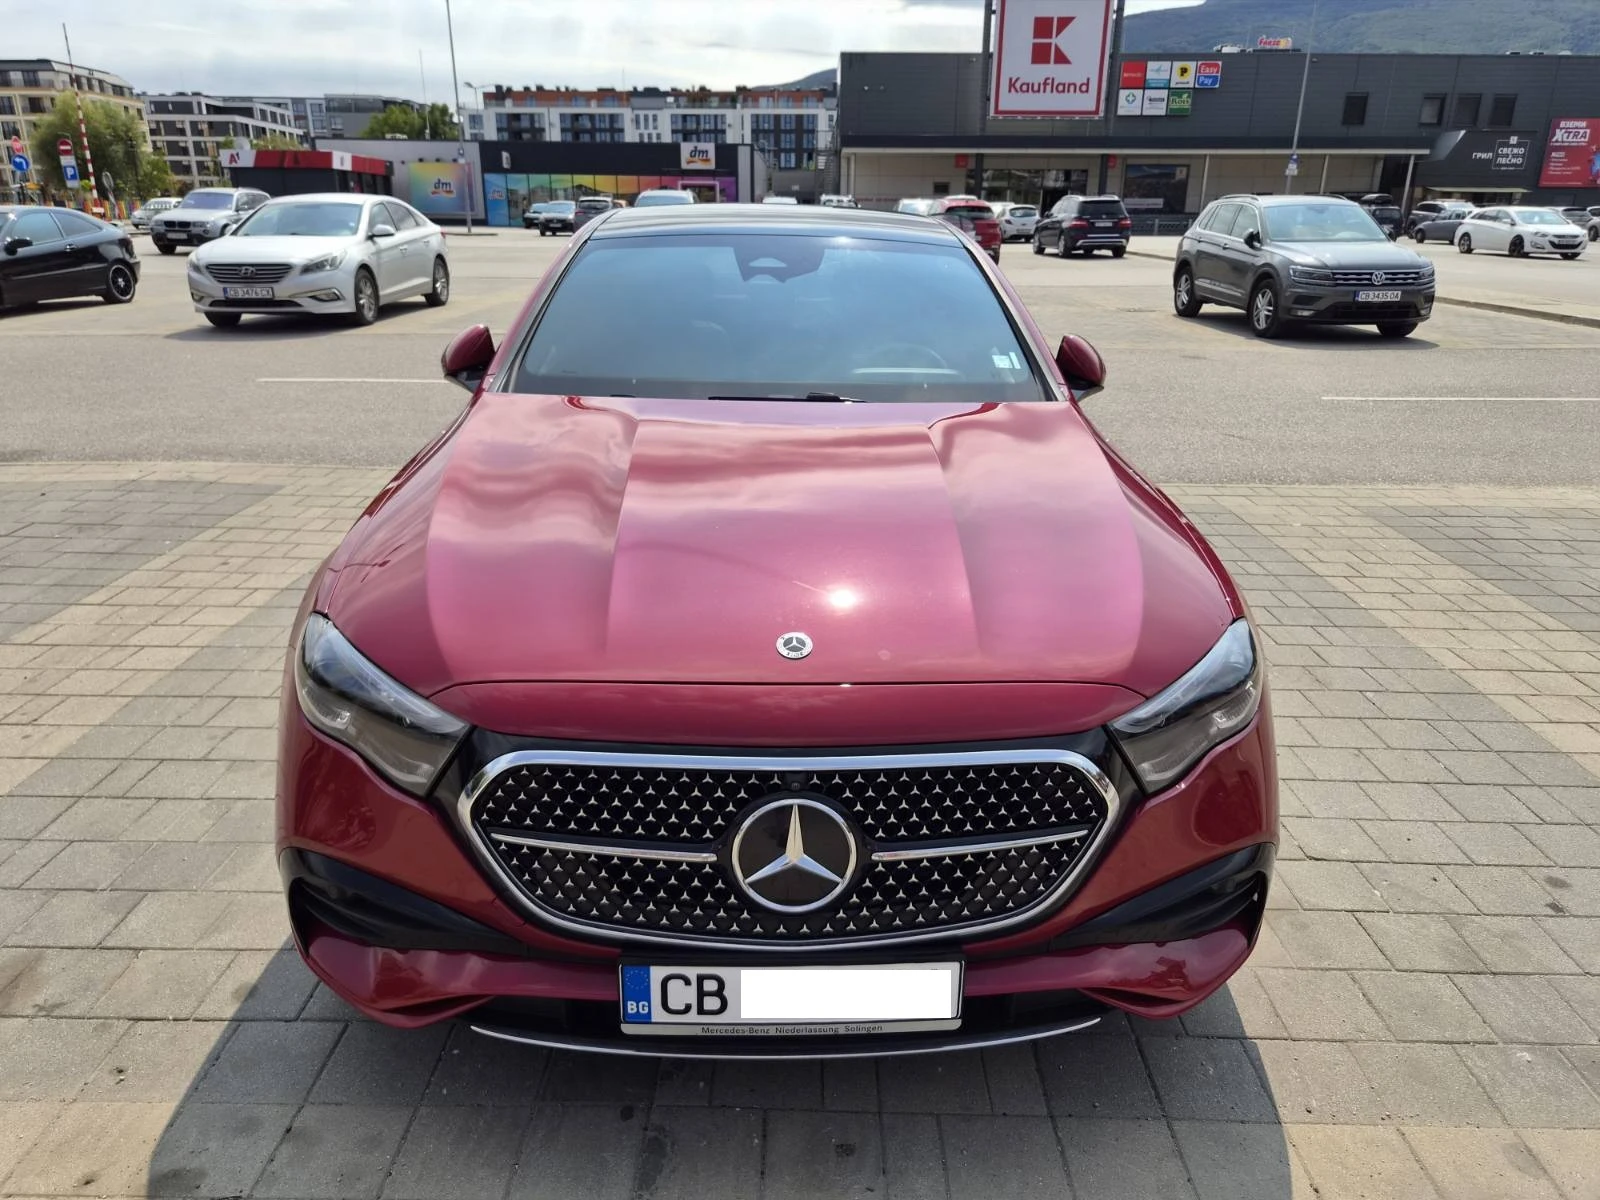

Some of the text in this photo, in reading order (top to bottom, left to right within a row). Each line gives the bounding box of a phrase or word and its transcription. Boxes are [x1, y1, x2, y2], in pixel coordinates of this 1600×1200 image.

[1200, 66, 1217, 74] Easy
[1008, 77, 1090, 93] Kaufland
[1199, 77, 1212, 85] Pay
[690, 146, 708, 158] dm
[1498, 147, 1525, 155] СВЕЖО
[66, 167, 75, 179] P
[434, 178, 452, 190] dm
[660, 973, 728, 1015] CB
[627, 1001, 649, 1014] BG
[701, 1025, 883, 1035] Mercedes-Benz Niederlassung Solingen
